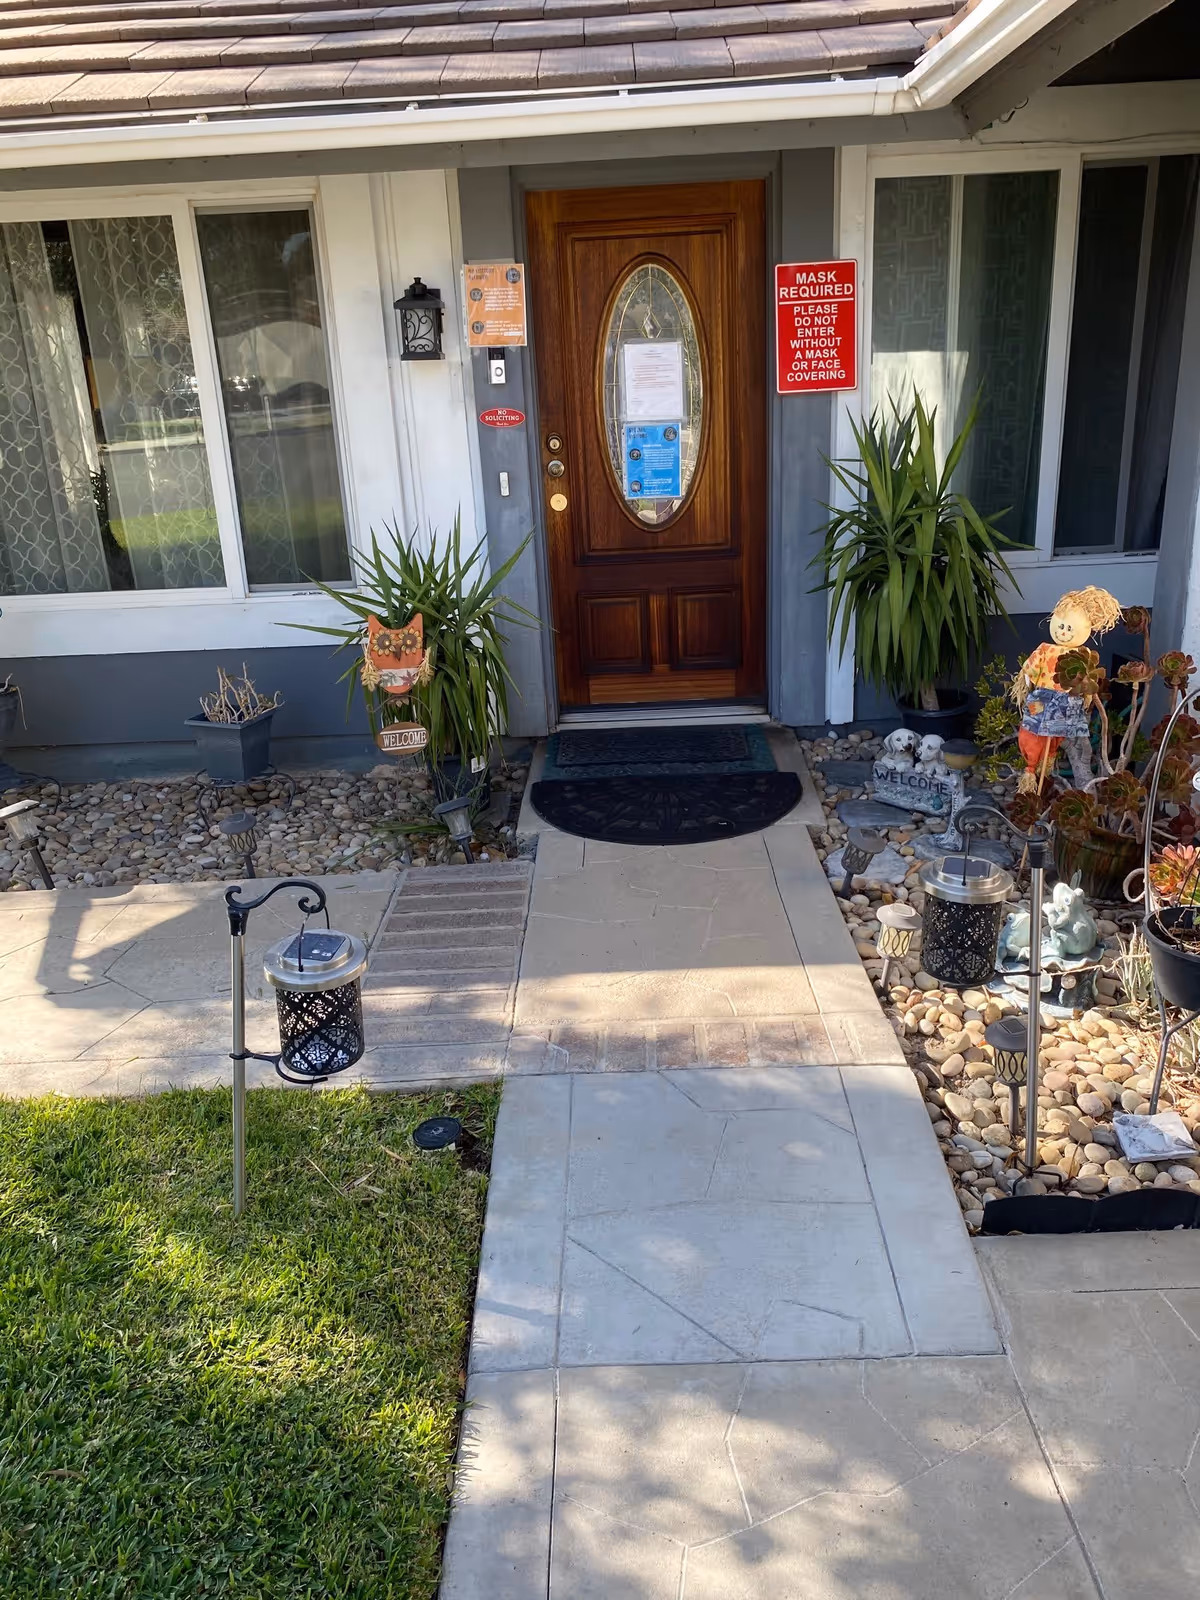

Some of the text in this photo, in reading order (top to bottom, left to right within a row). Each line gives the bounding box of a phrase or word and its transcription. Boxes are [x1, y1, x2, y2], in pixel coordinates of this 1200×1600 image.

[796, 271, 837, 284] MASK
[779, 284, 853, 299] REQUIRED
[794, 304, 838, 315] PLEASE
[795, 315, 838, 326] DO NOT
[798, 327, 835, 337] ENTER
[790, 337, 842, 348] WITHOUT
[795, 349, 837, 359] A MASK
[792, 360, 840, 370] OR FACE
[787, 370, 846, 381] COVERING
[383, 731, 427, 747] WELCOME
[875, 768, 949, 795] WELCOME
